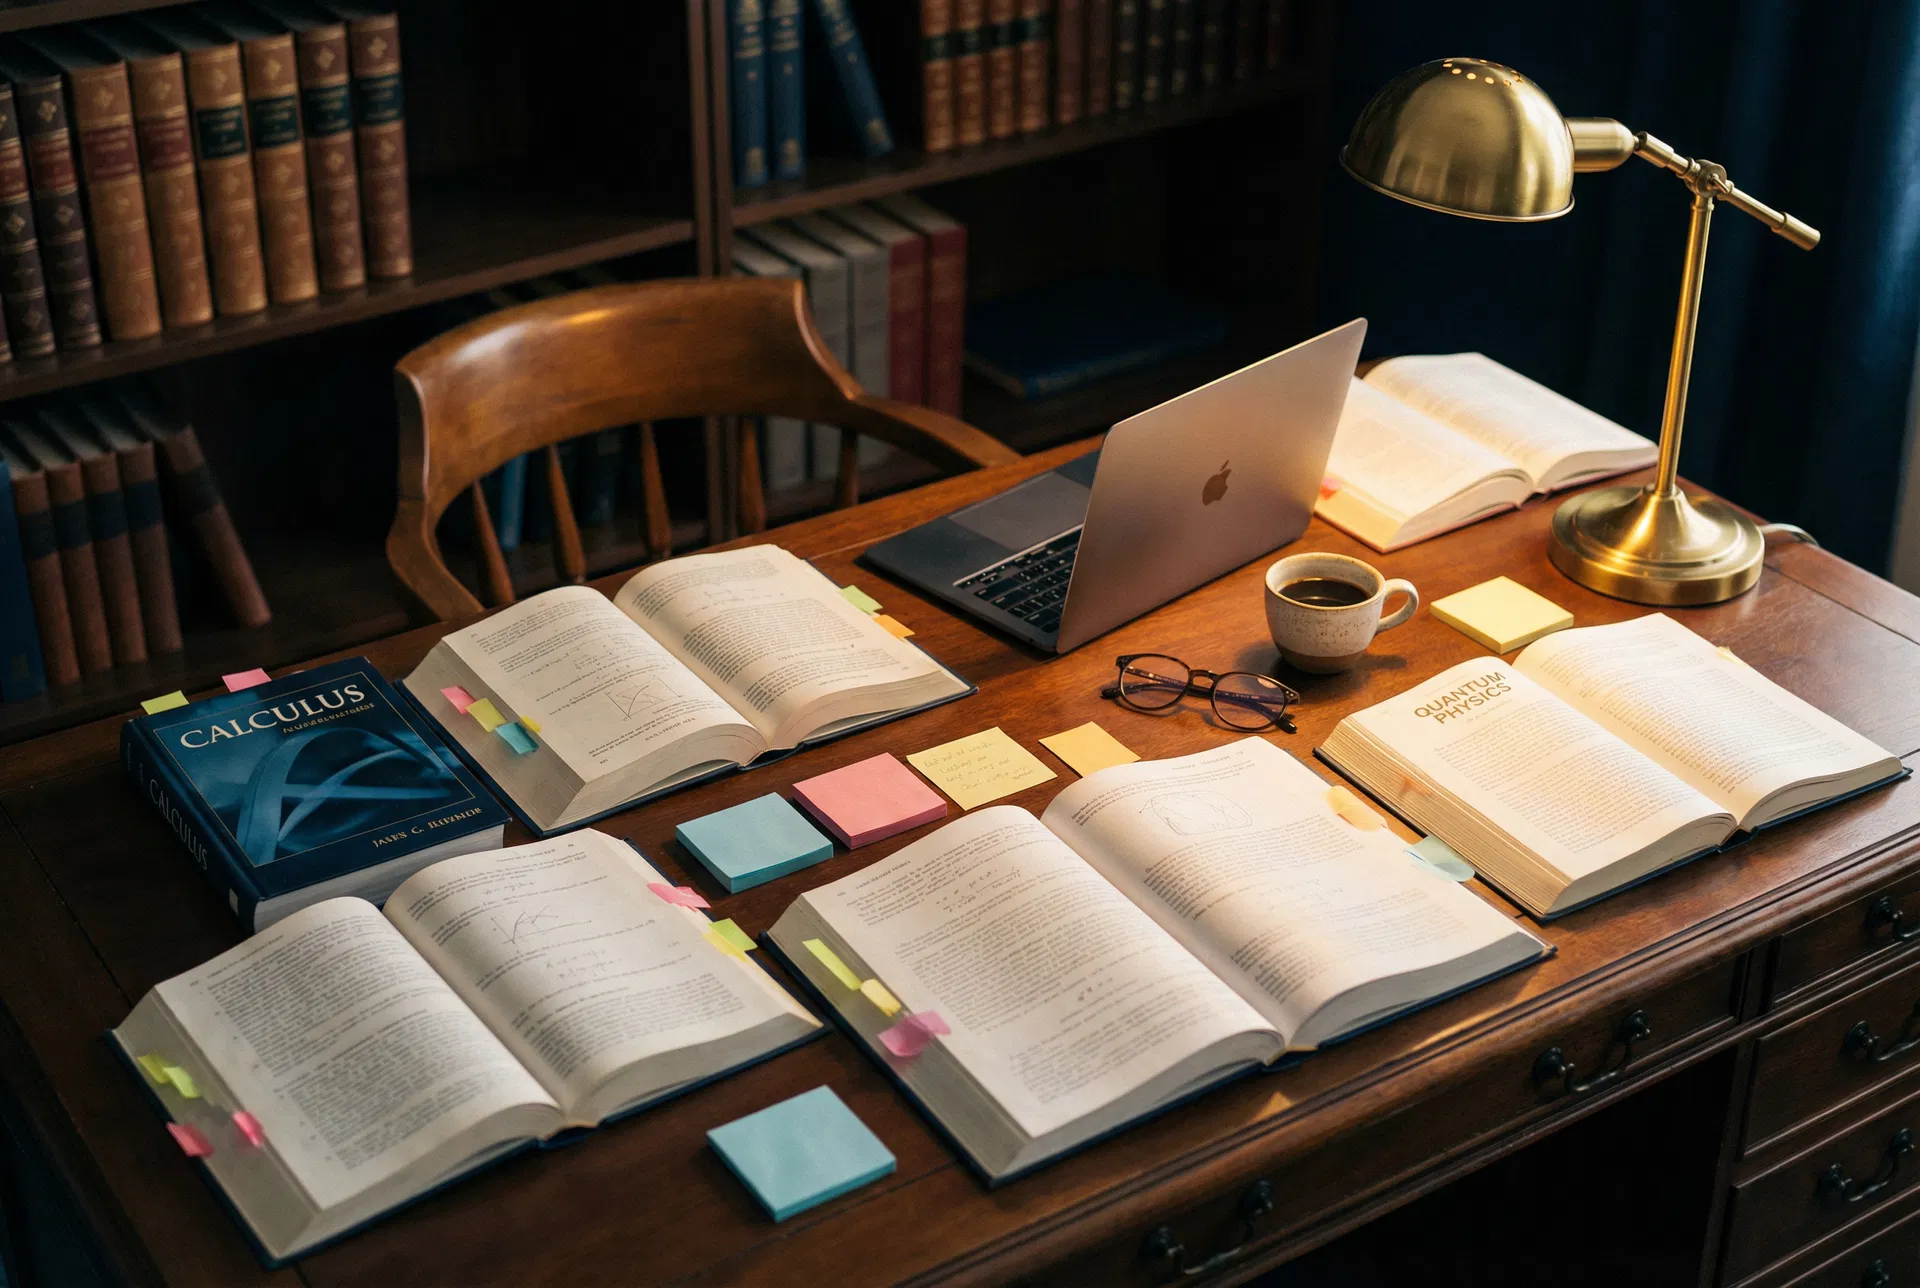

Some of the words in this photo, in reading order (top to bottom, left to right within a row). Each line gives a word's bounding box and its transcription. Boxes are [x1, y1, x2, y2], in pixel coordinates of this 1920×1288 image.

[180, 684, 366, 749] CALCULUS
[1414, 672, 1506, 718] QUANTUM
[1433, 682, 1512, 724] PHYSICS
[150, 778, 208, 870] CALCULUS
